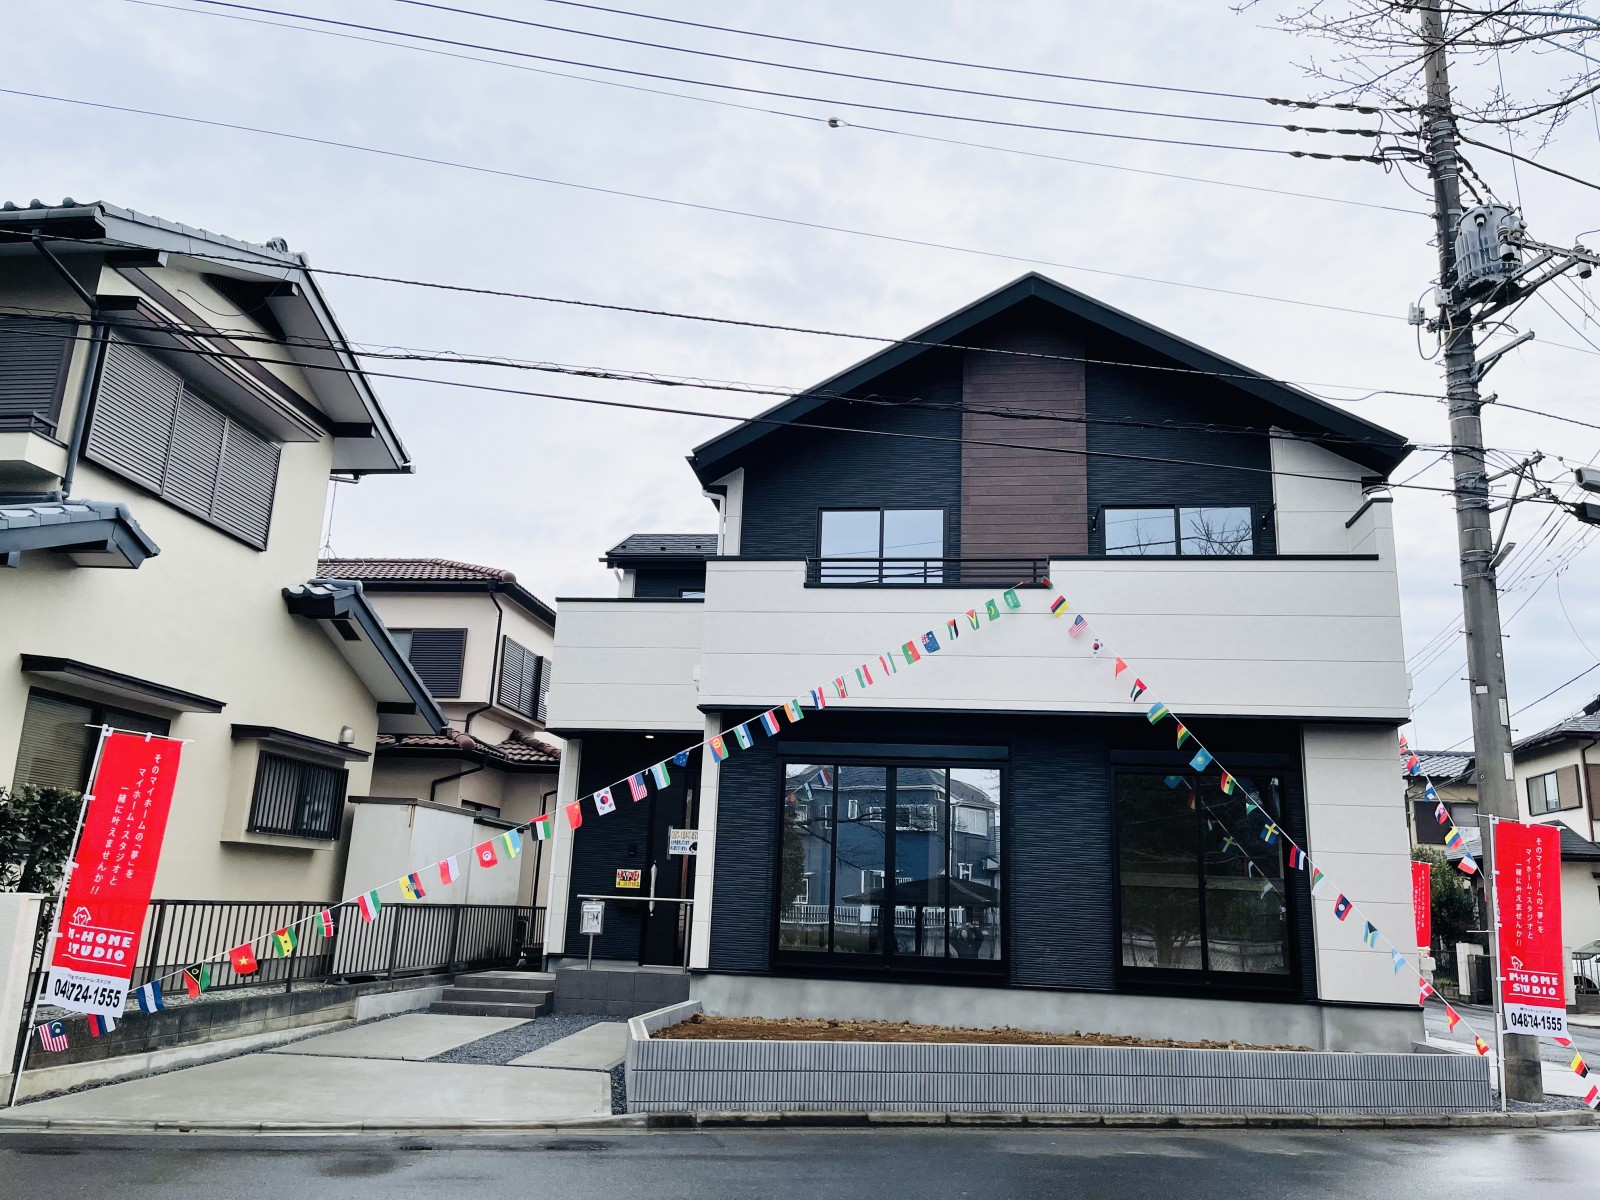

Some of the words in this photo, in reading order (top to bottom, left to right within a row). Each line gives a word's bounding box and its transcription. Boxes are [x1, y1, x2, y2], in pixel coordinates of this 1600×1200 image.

[109, 768, 146, 886] マイホーム・スタジオと
[125, 754, 162, 879] そのマイホームの「夢」を
[1525, 848, 1533, 939] マイホーム・スタジオと
[1535, 838, 1544, 934] そのマイホームの「夢」を
